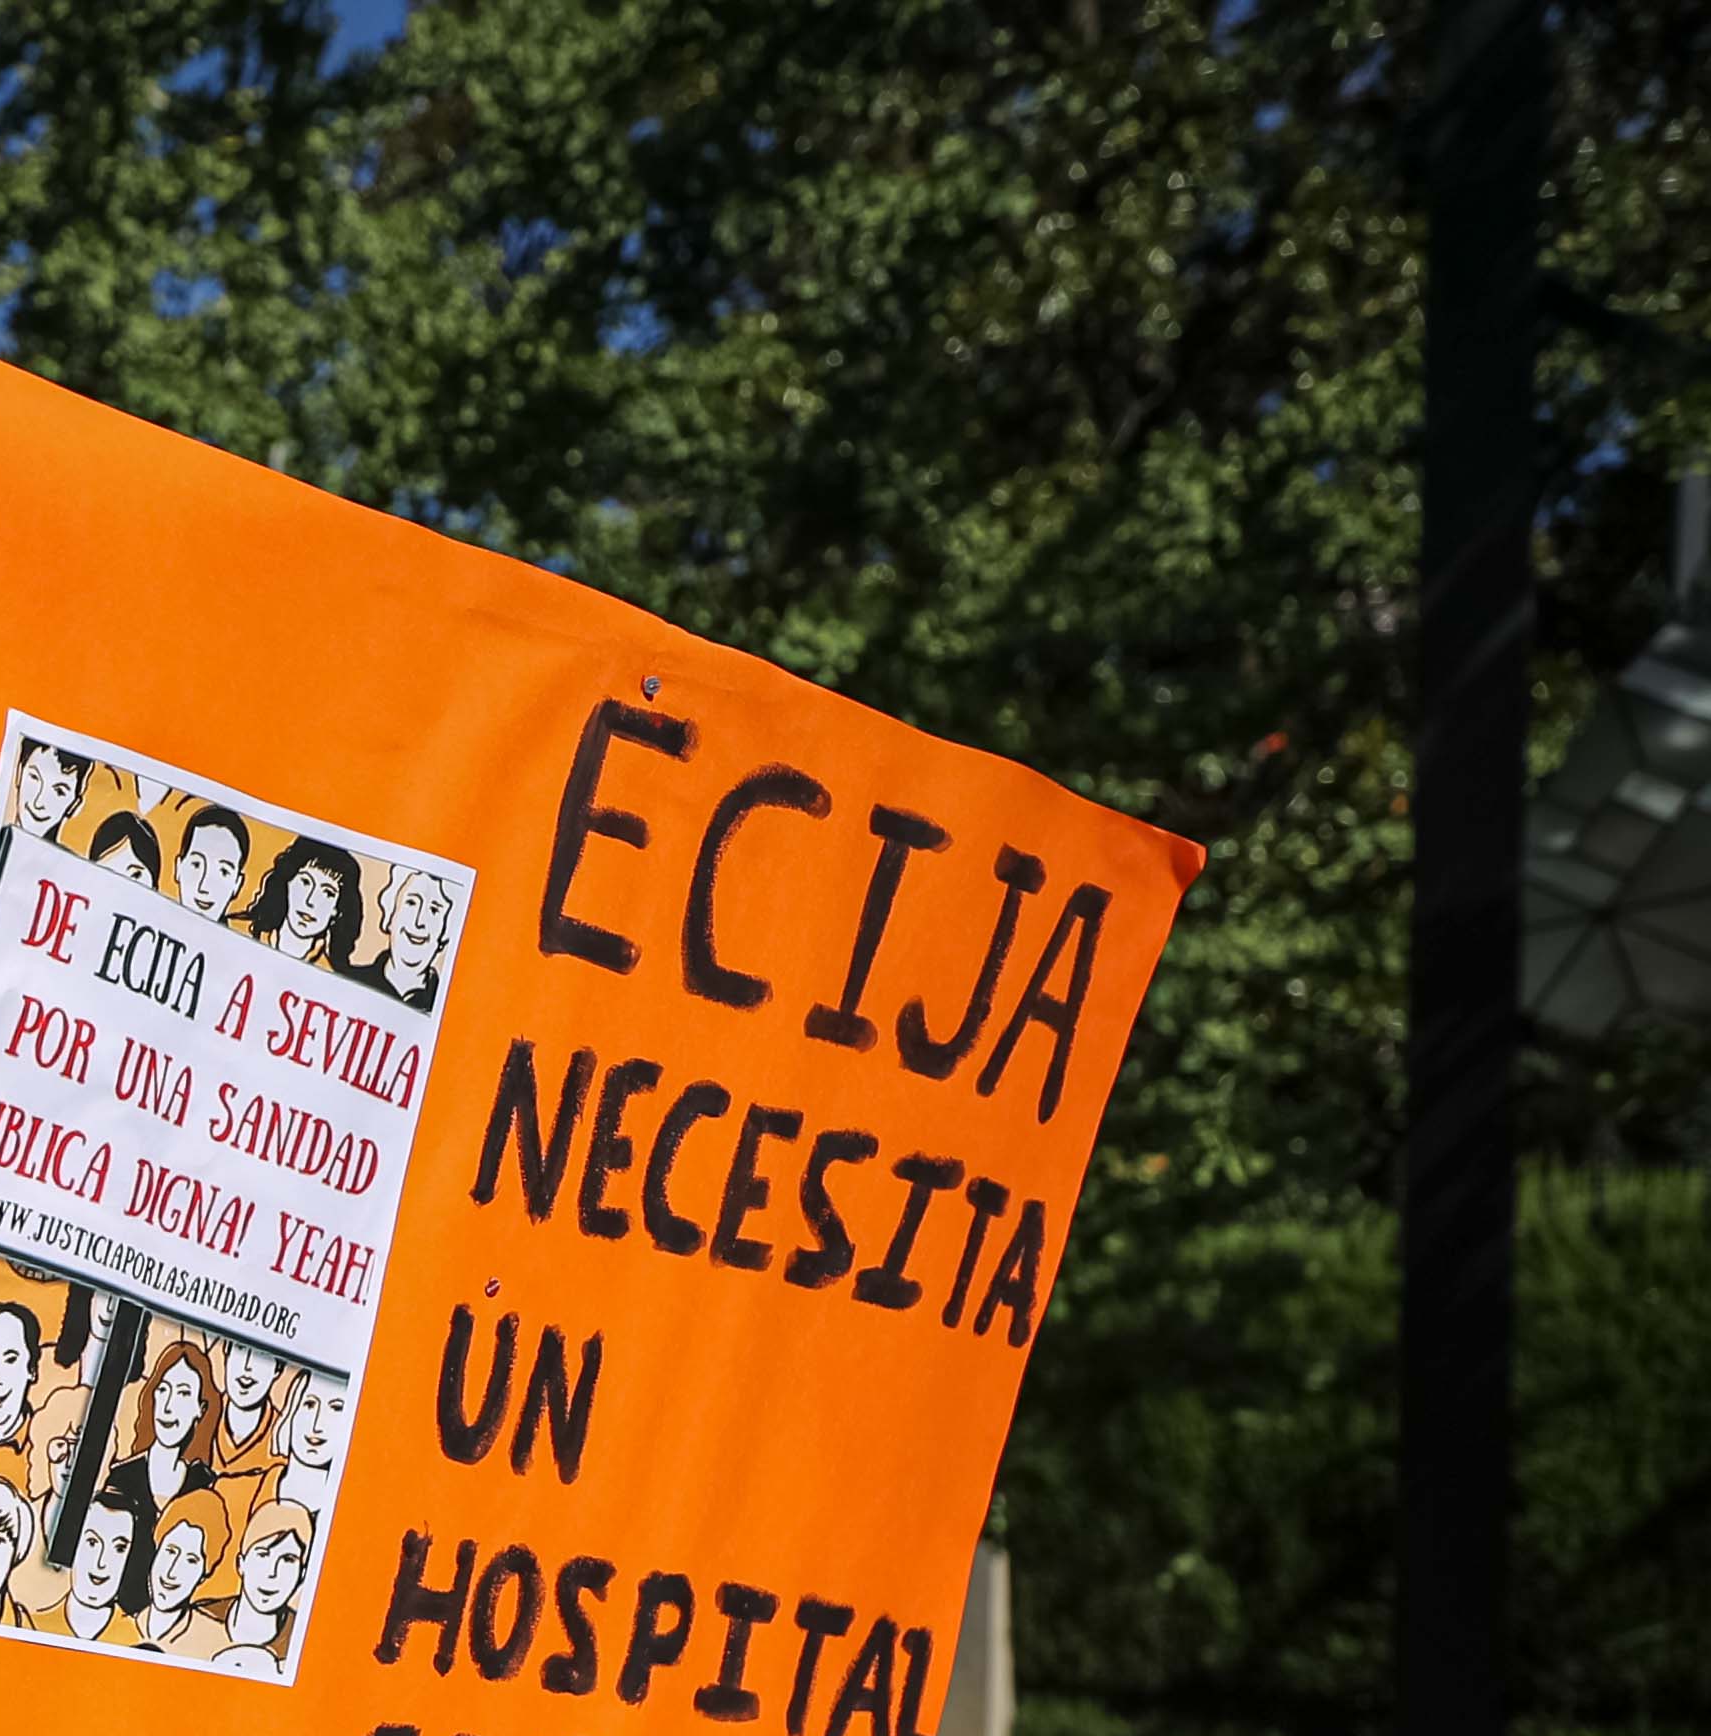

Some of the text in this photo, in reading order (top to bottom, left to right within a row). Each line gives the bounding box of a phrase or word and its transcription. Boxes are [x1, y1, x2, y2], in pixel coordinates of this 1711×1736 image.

[21, 879, 421, 1110] DE ECIJA A SEVILLA
[4, 995, 379, 1196] POR UNA SANIDAD
[468, 1034, 1046, 1349] NECESITA
[123, 1159, 256, 1259] DIGNA!
[270, 1211, 376, 1306] YEAH!
[436, 1303, 604, 1484] UN
